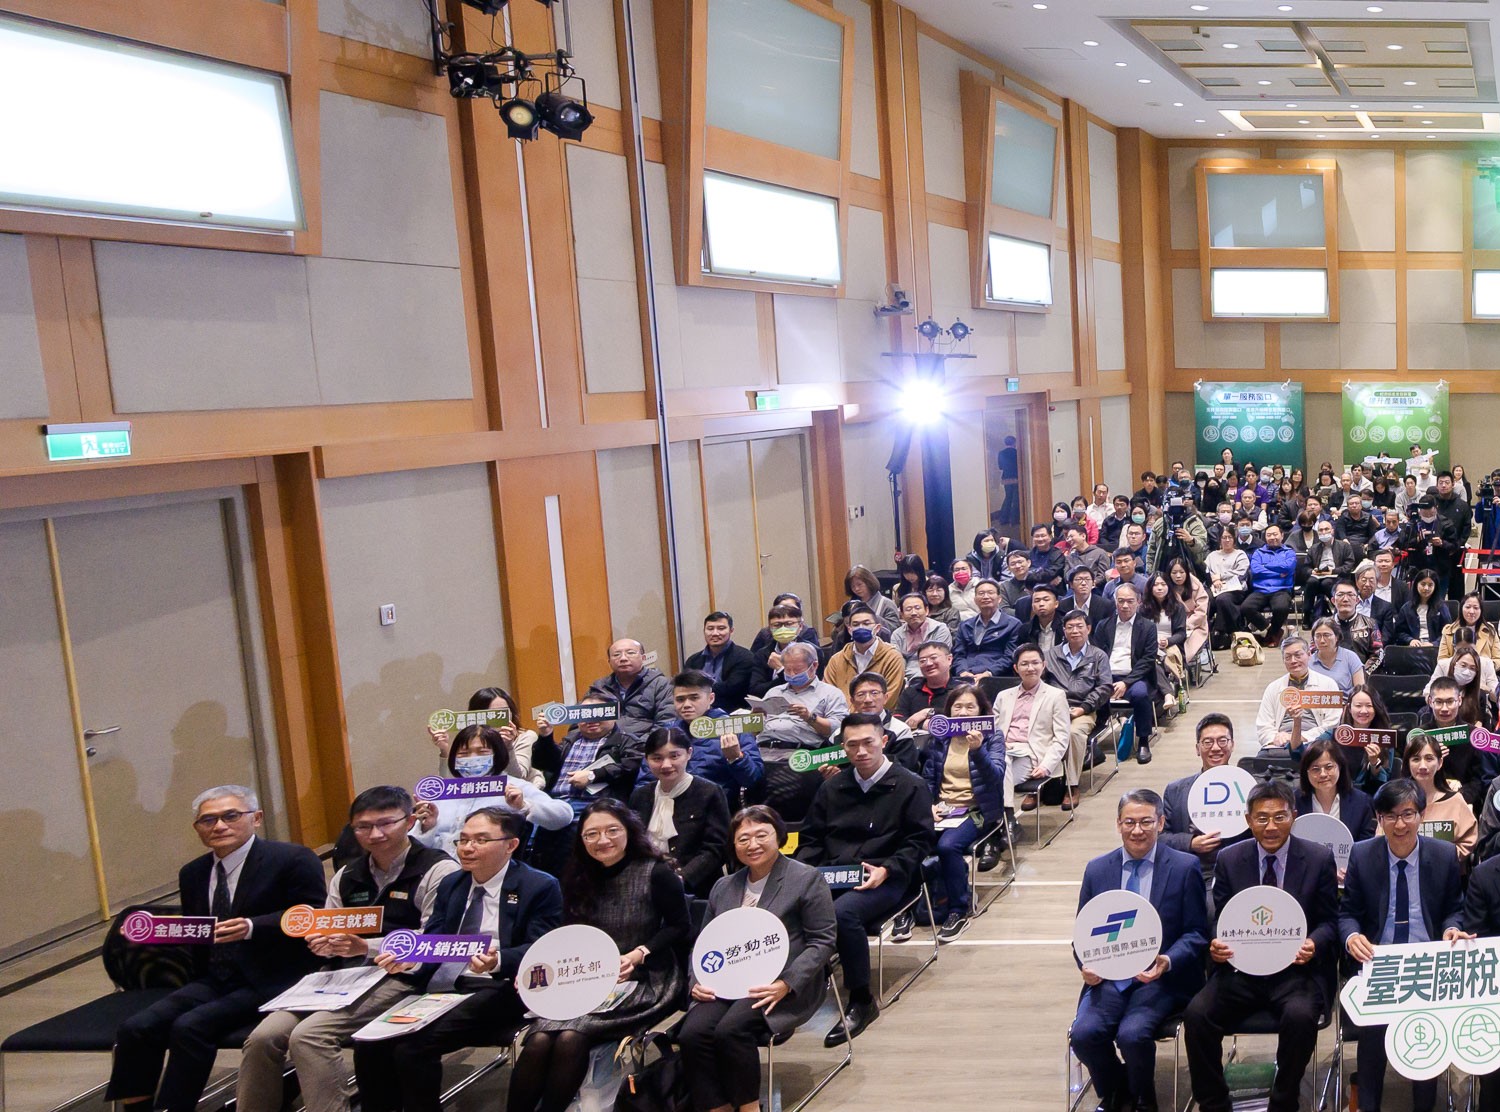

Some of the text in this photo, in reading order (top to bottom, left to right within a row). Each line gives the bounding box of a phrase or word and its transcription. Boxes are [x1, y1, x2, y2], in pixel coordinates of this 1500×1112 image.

[1301, 695, 1340, 705] 安定就業
[568, 706, 616, 719] 研發轉型
[950, 721, 993, 732] 外銷拓點
[1358, 733, 1391, 744] 注資金
[1432, 730, 1467, 742] 練有津貼
[446, 781, 503, 795] 外銷拓點
[821, 870, 860, 883] 發轉型
[315, 913, 378, 929] 安定就業
[154, 923, 212, 938] 金融支持
[415, 941, 486, 956] 外銷拓點
[725, 933, 780, 959] 勞動部
[1083, 936, 1158, 959] 經濟部國際貿易署
[727, 955, 752, 966] Ministry
[557, 961, 602, 978] 財政部
